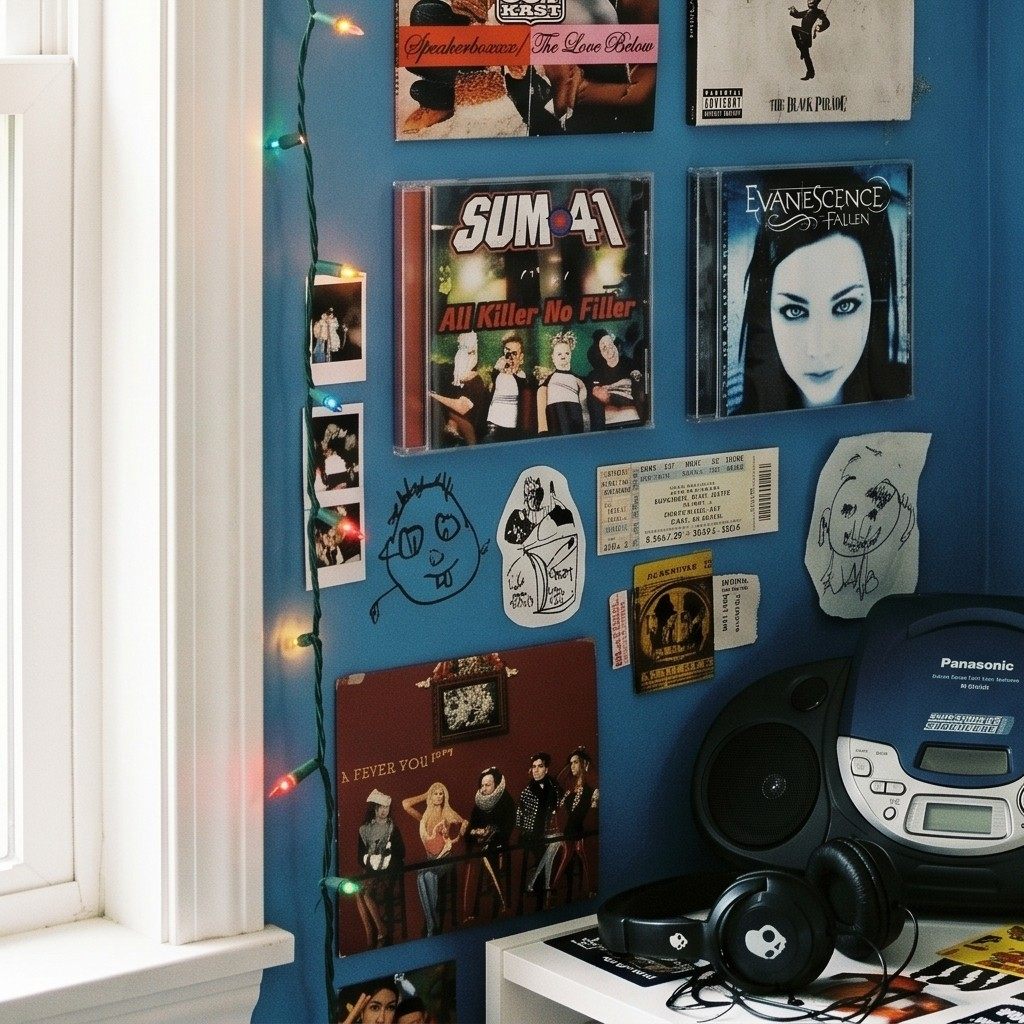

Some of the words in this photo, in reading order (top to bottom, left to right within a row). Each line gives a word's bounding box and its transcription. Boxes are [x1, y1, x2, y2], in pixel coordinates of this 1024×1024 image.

[532, 31, 558, 55] The
[562, 31, 602, 54] Love
[604, 29, 655, 54] Below
[745, 183, 885, 216] EVANESCENCE
[452, 191, 552, 254] SUM
[571, 189, 628, 248] 41
[822, 211, 870, 231] FALLEN
[439, 304, 473, 332] All
[477, 301, 539, 329] Killer
[544, 299, 573, 324] No
[580, 295, 637, 322] Filler
[941, 657, 1015, 671] Panasonic
[341, 771, 349, 783] A
[353, 762, 396, 781] FEVER
[399, 755, 428, 771] YOU
